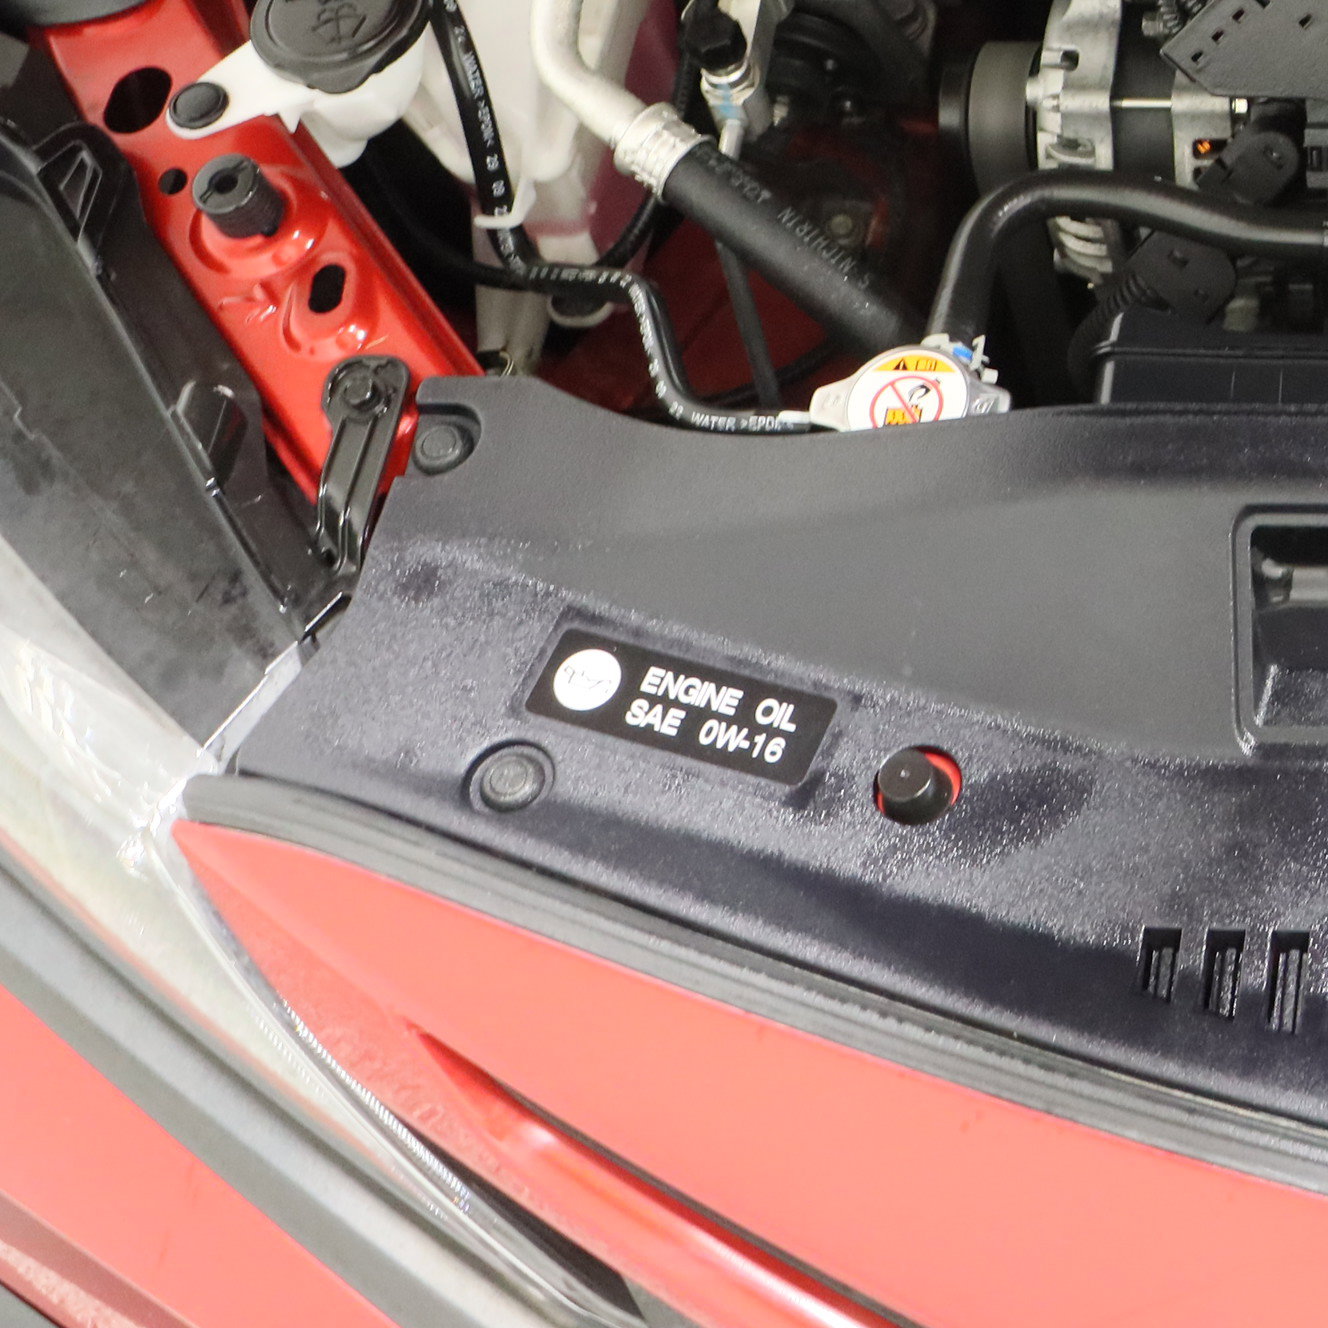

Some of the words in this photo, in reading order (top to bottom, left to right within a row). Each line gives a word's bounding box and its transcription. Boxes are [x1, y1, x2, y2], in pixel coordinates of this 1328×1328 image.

[691, 411, 737, 433] WATER
[625, 698, 687, 737] SAE
[698, 718, 787, 764] 0W-16
[640, 666, 744, 717] ENGINE
[754, 697, 797, 734] OIL
